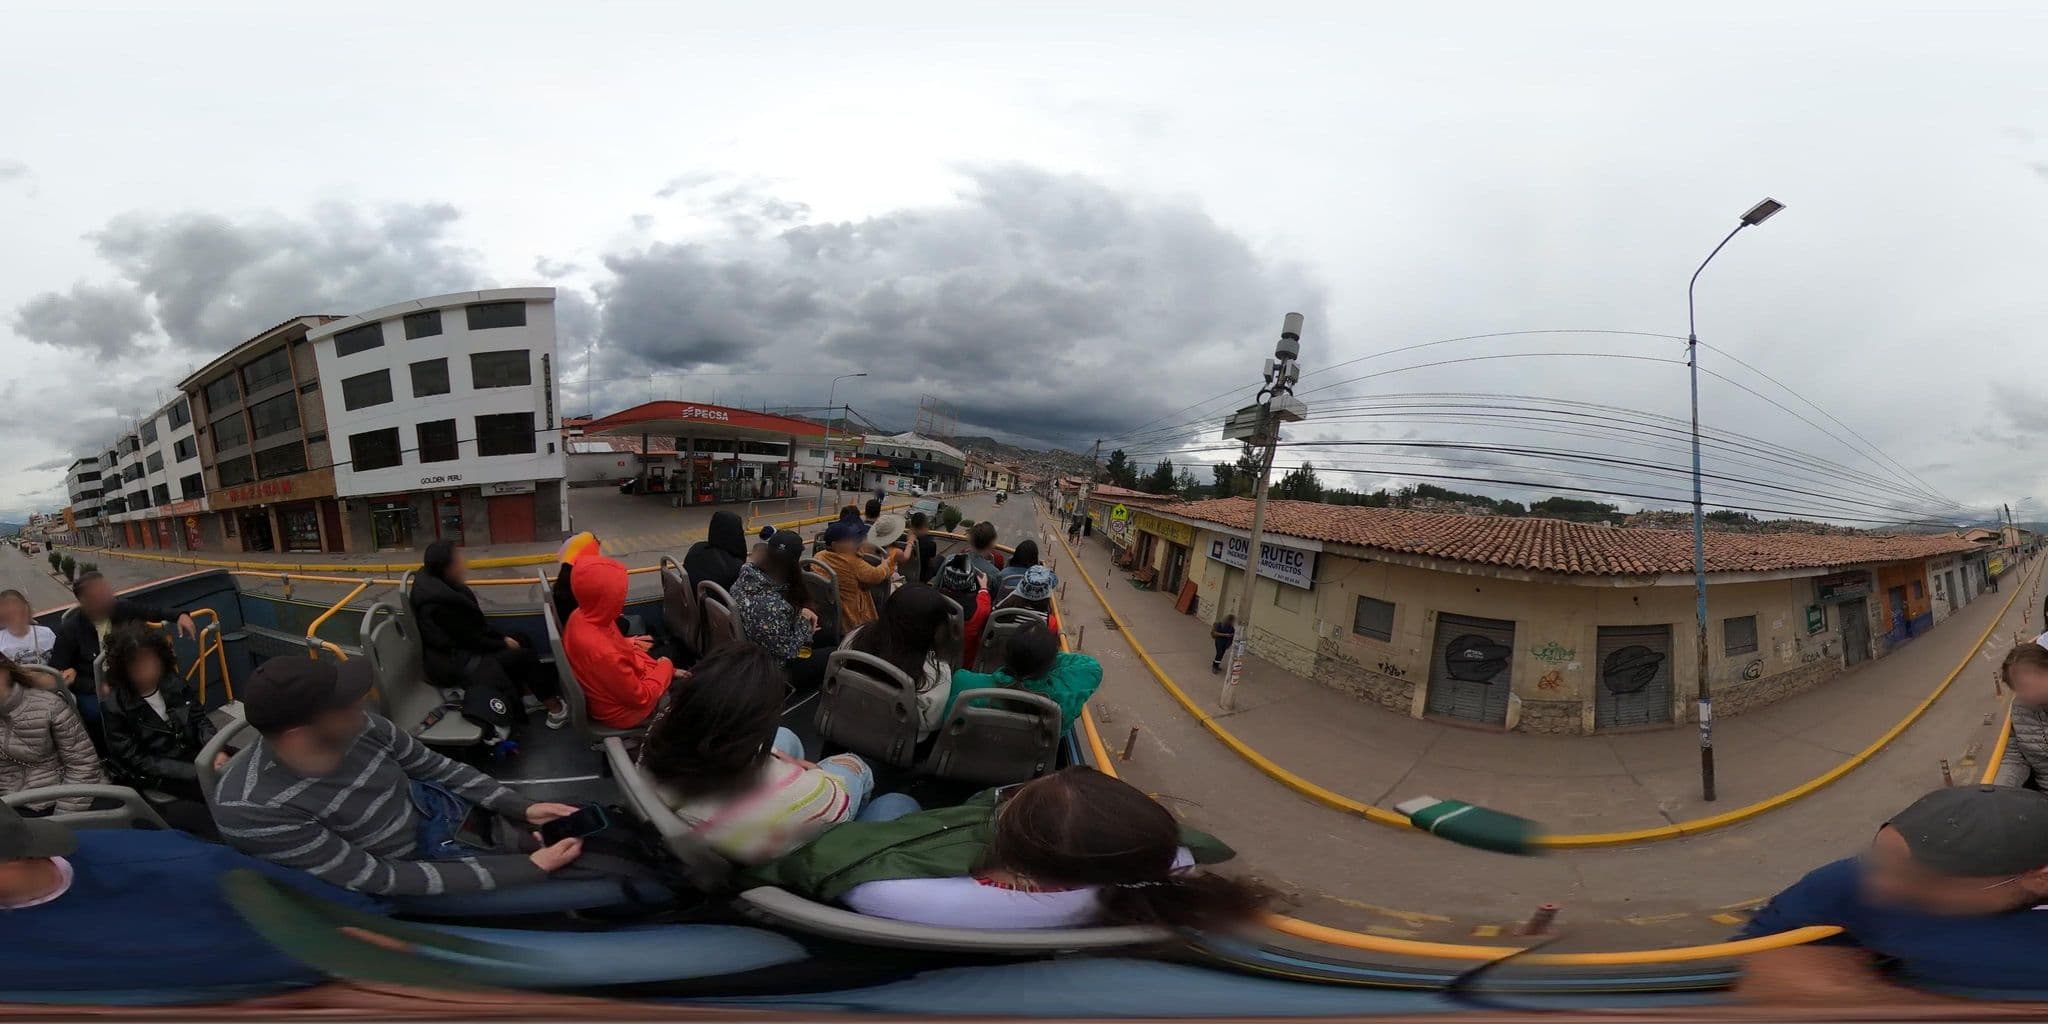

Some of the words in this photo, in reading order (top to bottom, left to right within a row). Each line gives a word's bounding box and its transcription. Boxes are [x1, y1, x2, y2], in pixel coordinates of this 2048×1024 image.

[694, 408, 729, 421] PECSA
[420, 475, 446, 485] GOLDEN
[447, 473, 463, 482] PERU
[1229, 537, 1304, 568] CONRUTEC
[1261, 559, 1302, 576] ARQUITECTOS
